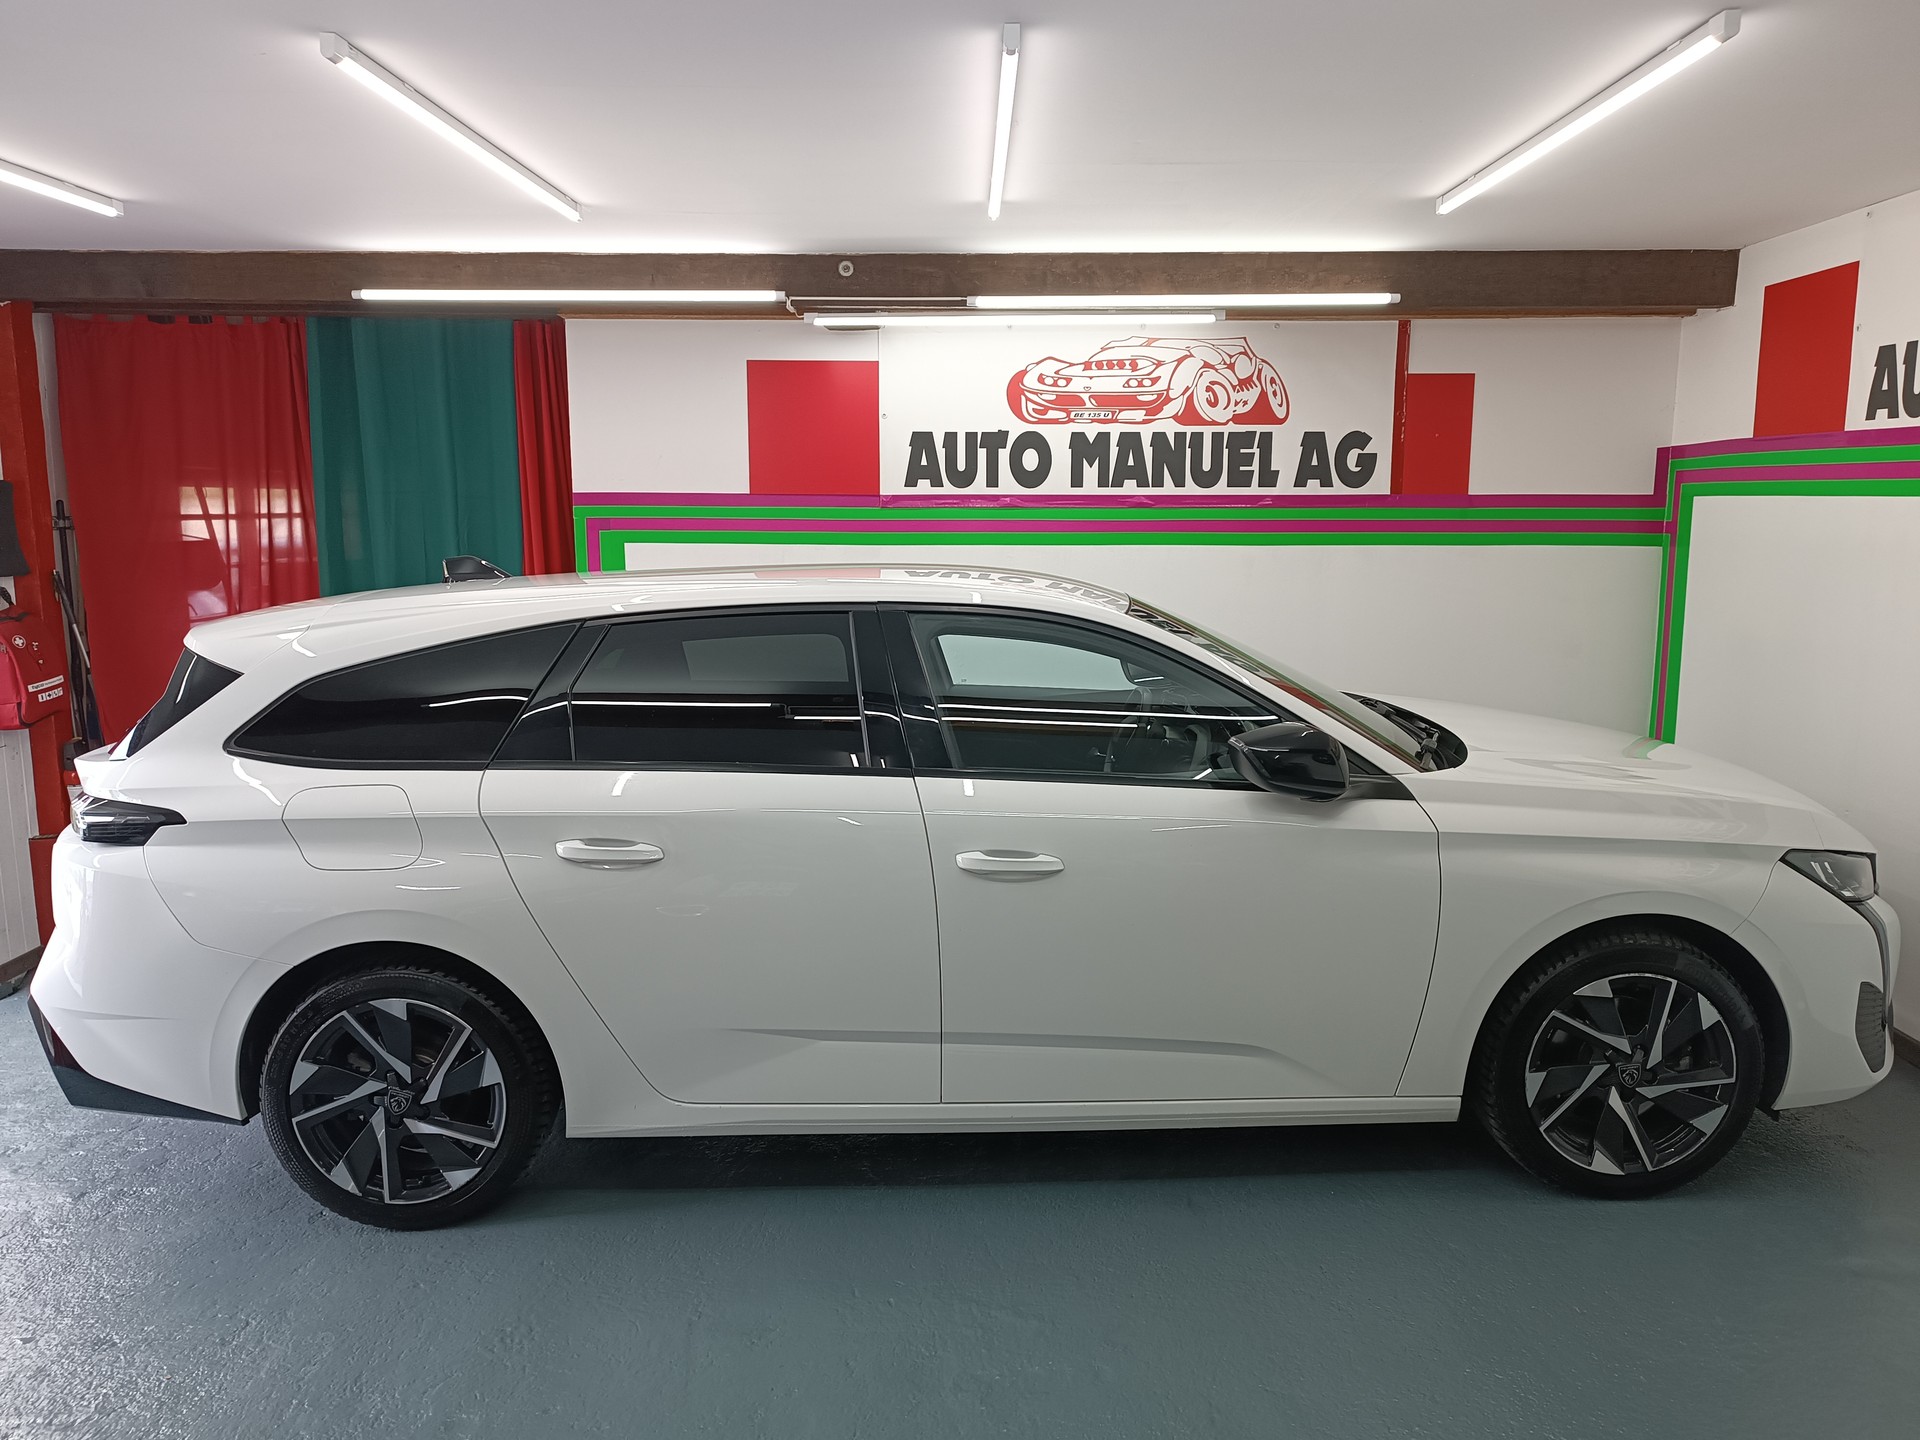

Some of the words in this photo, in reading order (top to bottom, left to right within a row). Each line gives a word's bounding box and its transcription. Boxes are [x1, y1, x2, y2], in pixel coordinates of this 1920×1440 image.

[904, 429, 1052, 488] AUTO
[1068, 430, 1280, 488] MANUEL
[1293, 430, 1378, 488] AG
